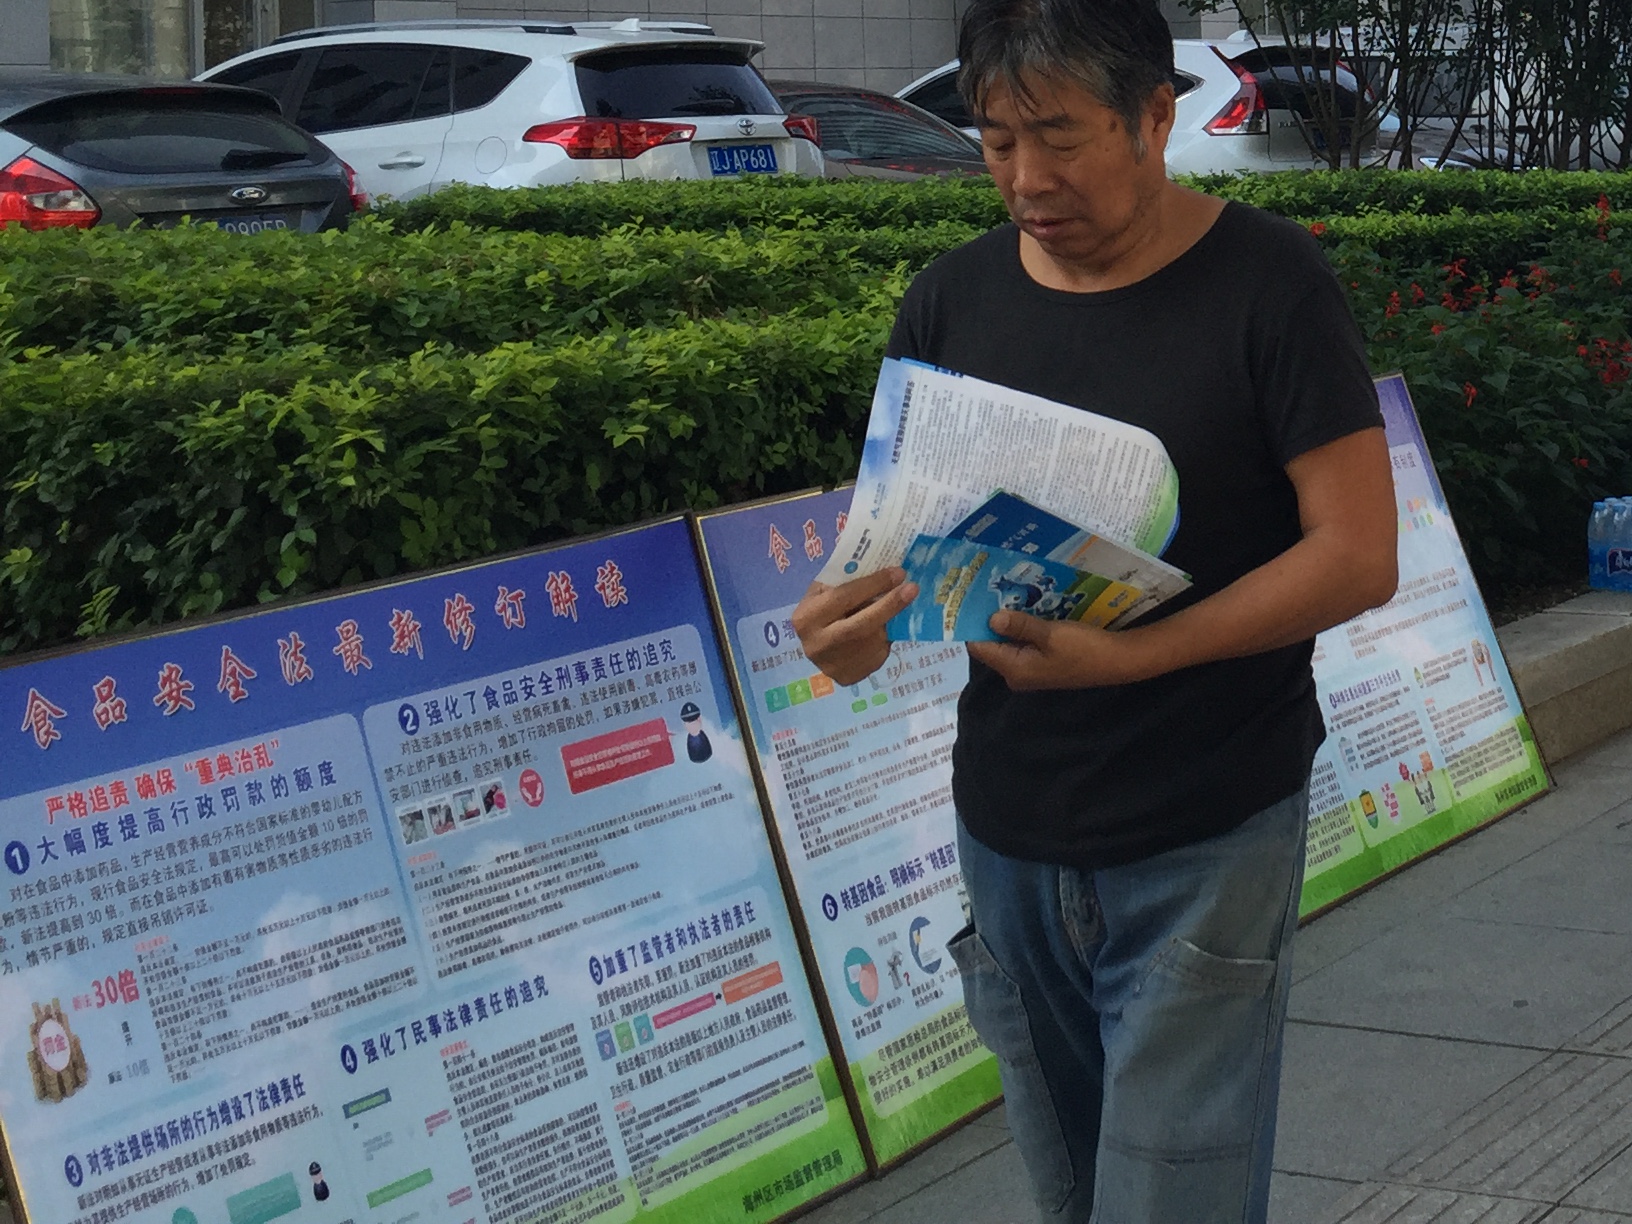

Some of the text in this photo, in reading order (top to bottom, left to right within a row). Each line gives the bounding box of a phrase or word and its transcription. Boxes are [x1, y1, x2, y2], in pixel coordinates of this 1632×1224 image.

[20, 559, 629, 750] 食品安全法最新修订解读
[426, 638, 677, 726] 强化了食品安全刑事责任的追究
[37, 760, 337, 865] 大幅度提高行政罚款的额度
[46, 779, 128, 825] 严格追责
[362, 975, 551, 1065] 强化了民事法律责任的追究
